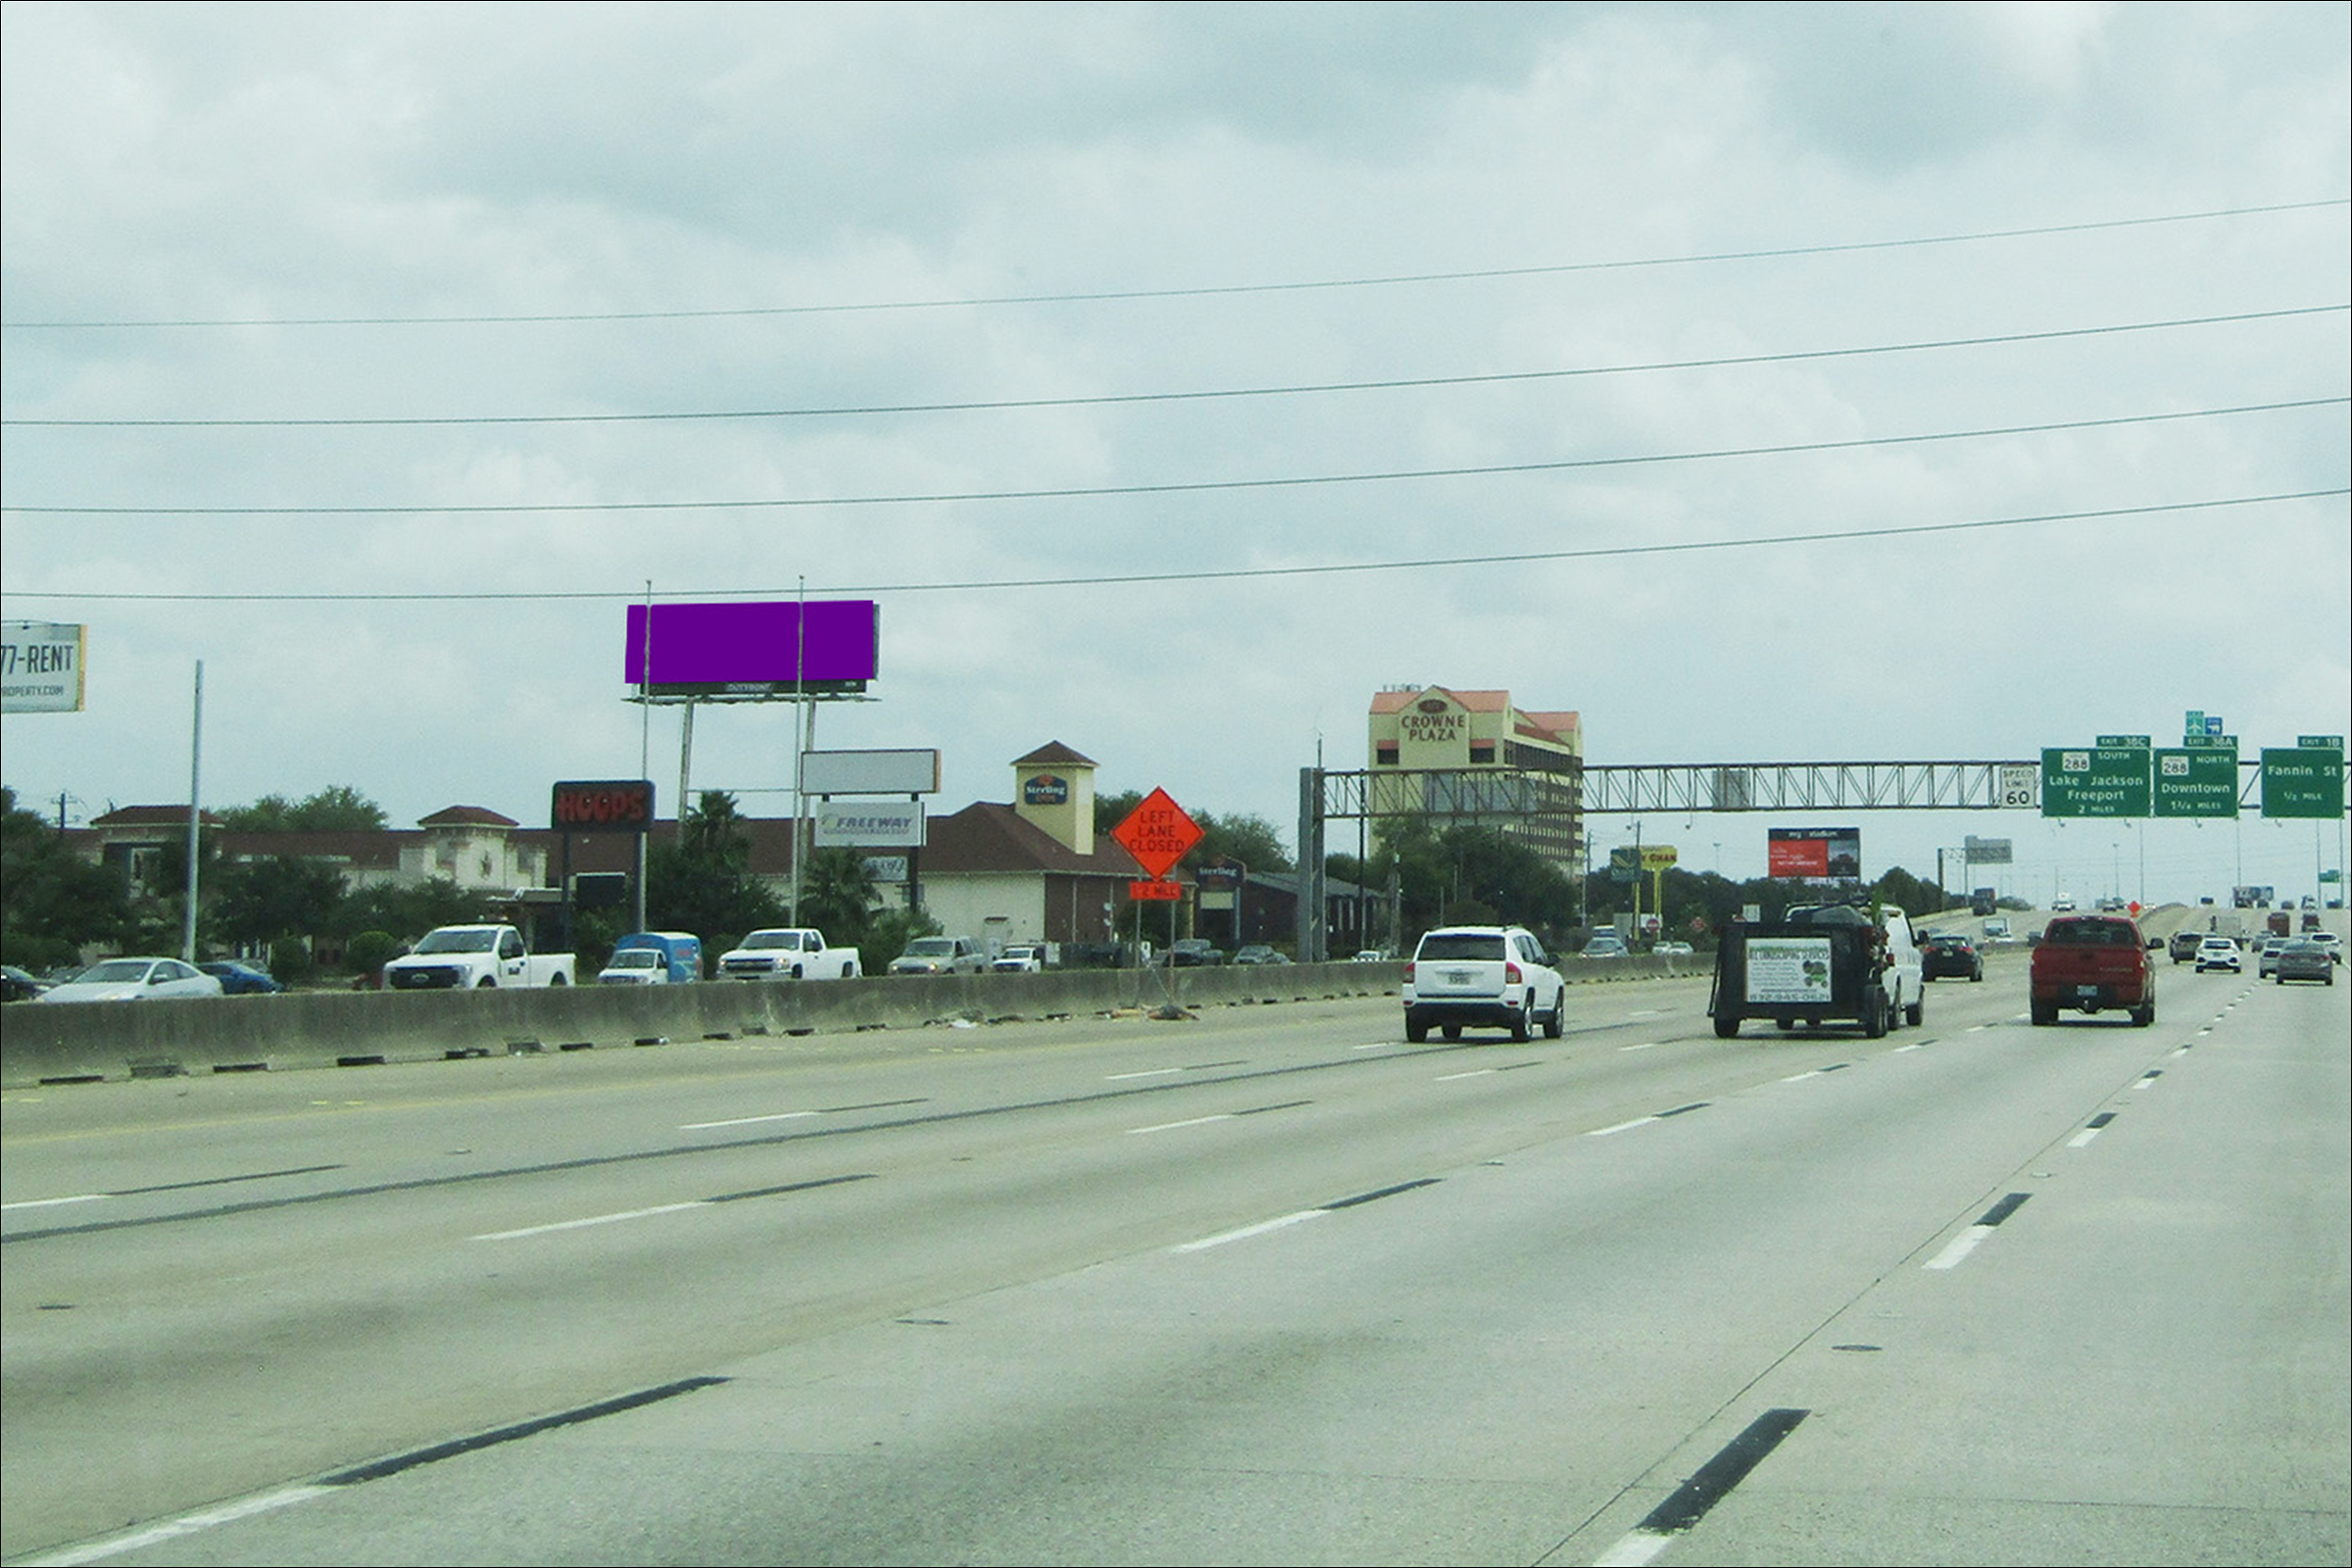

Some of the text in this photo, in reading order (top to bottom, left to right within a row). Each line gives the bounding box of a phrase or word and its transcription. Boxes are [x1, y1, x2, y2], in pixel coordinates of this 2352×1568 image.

[1401, 715, 1465, 728] CROWNE
[1409, 729, 1456, 742] PLAZA
[2064, 759, 2088, 770] 288
[2196, 756, 2230, 764] NORTH
[2163, 762, 2187, 773] 288
[2268, 765, 2337, 777] Fannin St
[2049, 775, 2143, 787] Lake Jackson
[1026, 786, 1066, 796] Sterling
[2161, 783, 2230, 794] Downtown
[2006, 791, 2030, 805] 60
[2068, 790, 2124, 802] Freeport
[2079, 805, 2085, 813] 2
[837, 817, 912, 828] FREEWAY
[1140, 810, 1175, 824] LEFT
[1138, 825, 1175, 838] LANE
[1129, 839, 1185, 853] CLOSED
